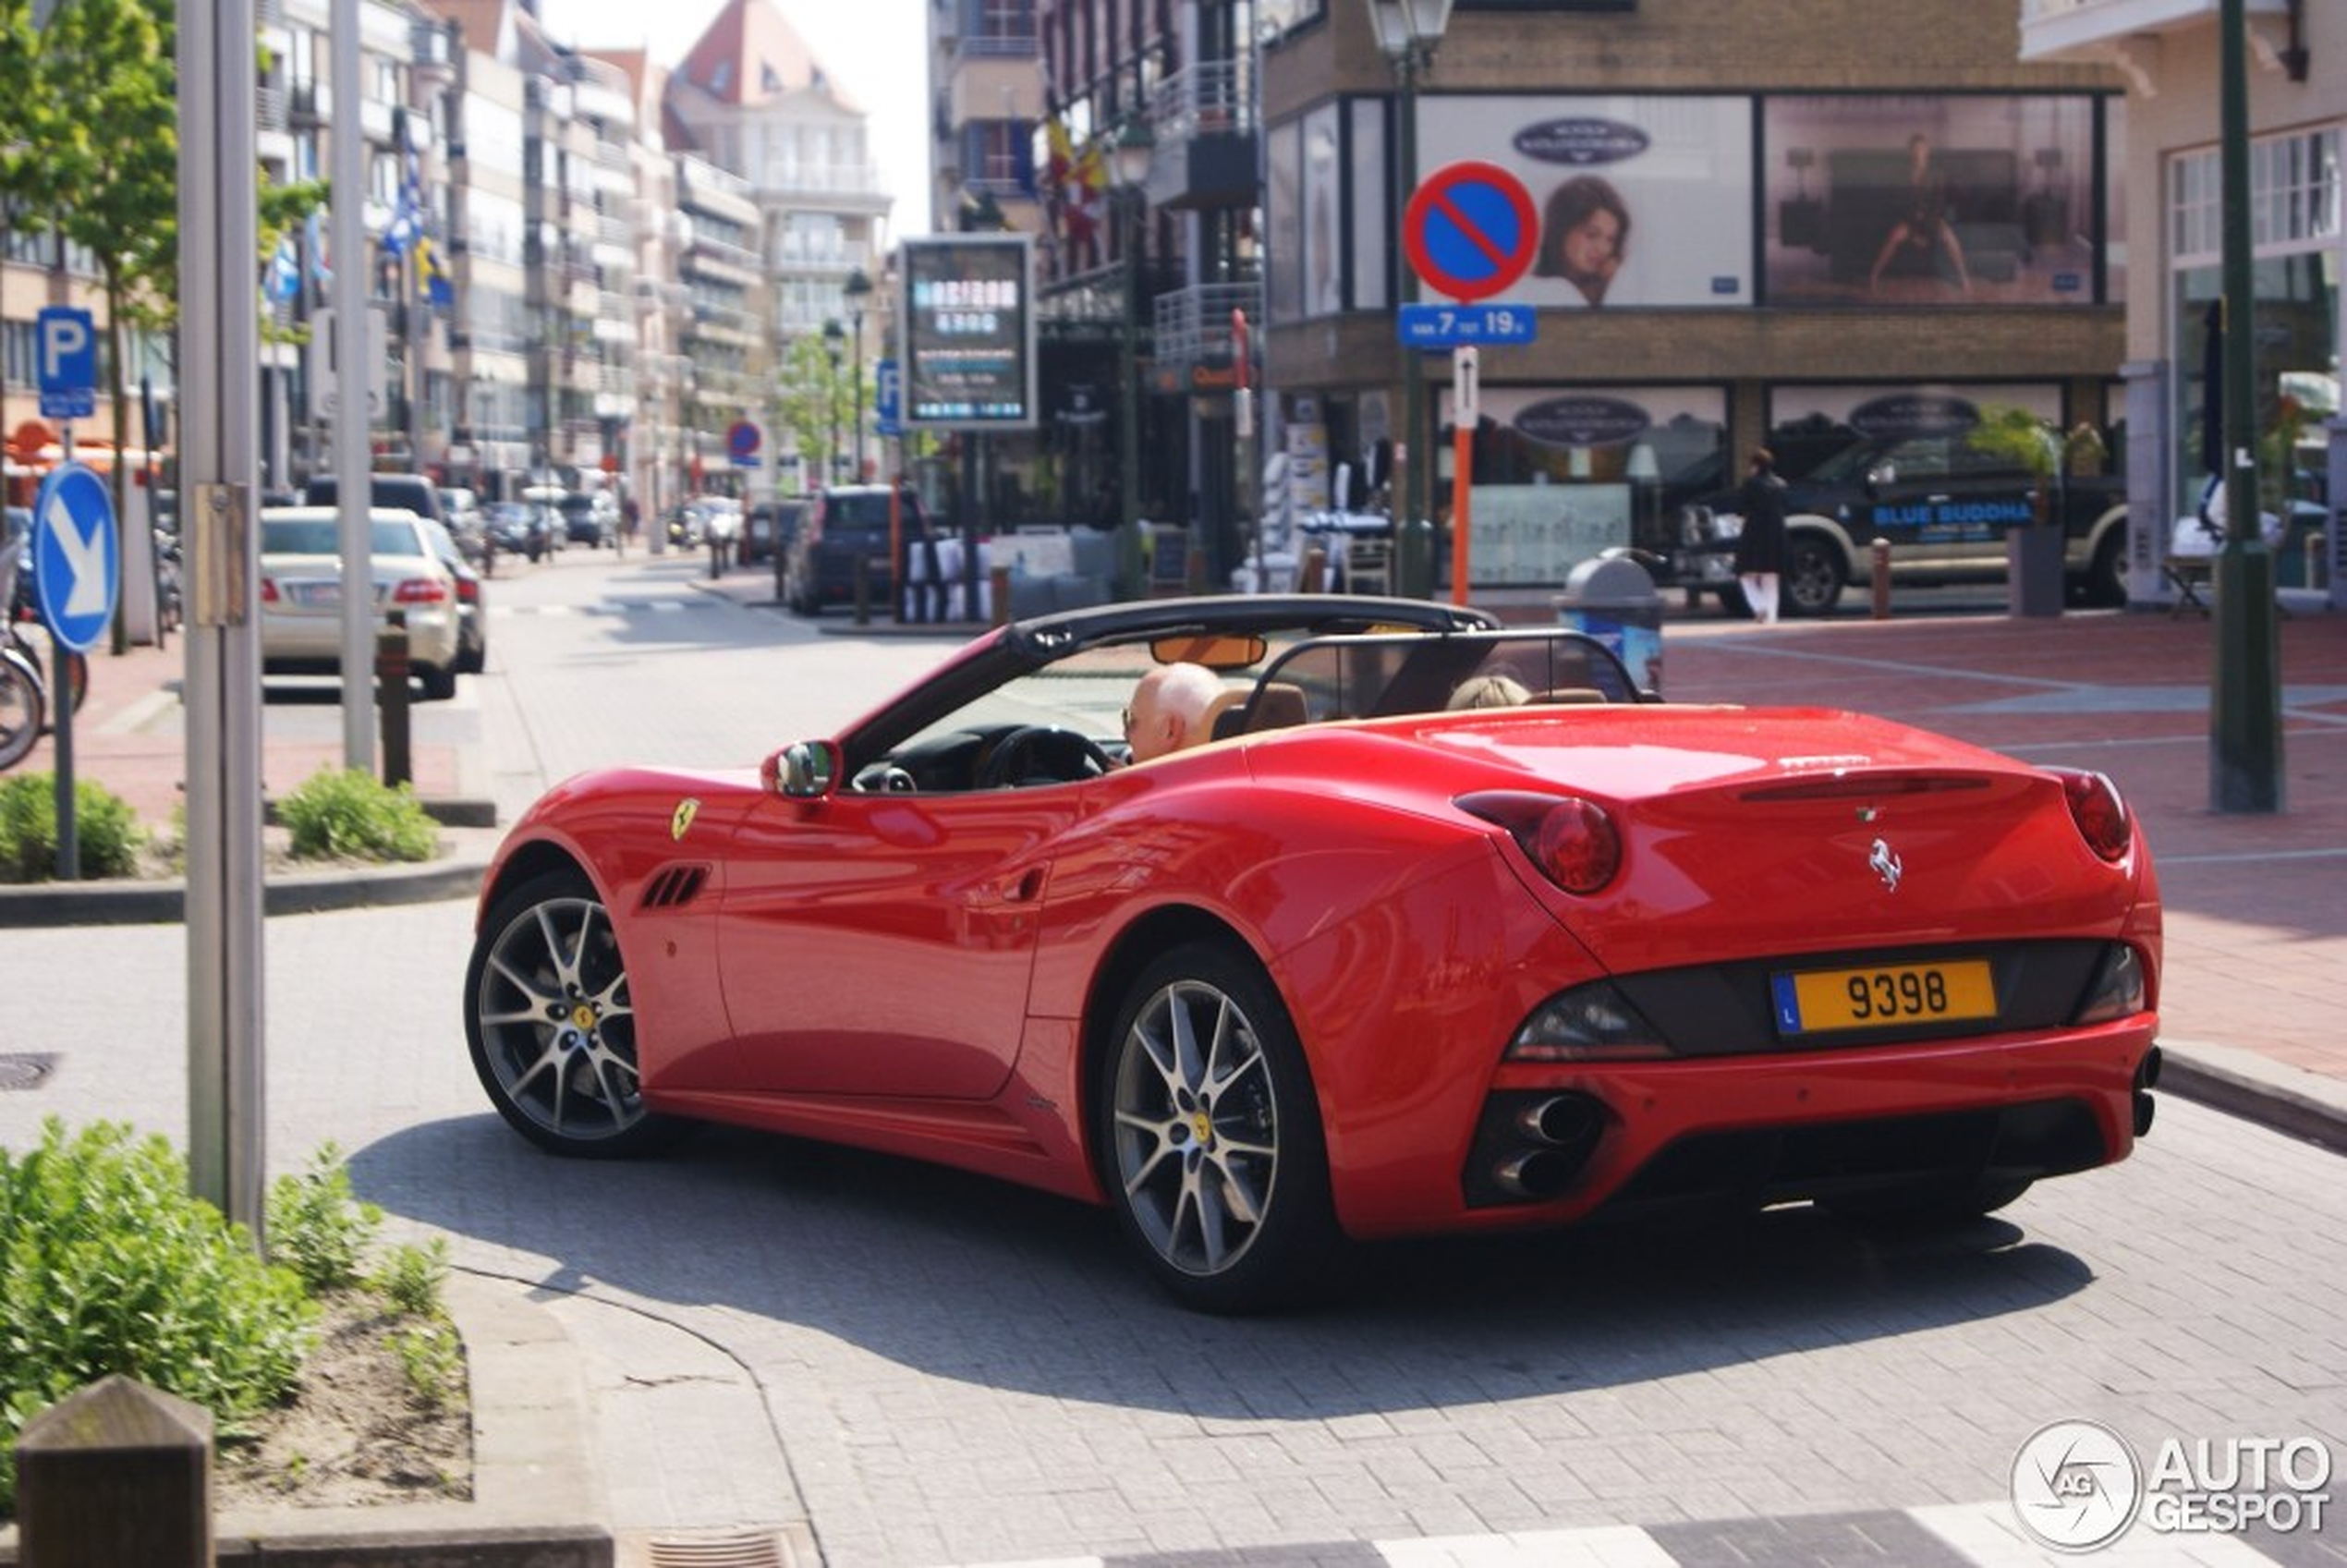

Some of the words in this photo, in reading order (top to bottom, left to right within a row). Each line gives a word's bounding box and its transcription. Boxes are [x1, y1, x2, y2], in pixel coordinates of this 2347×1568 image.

[1438, 311, 1456, 334] 7
[1486, 310, 1514, 334] 19
[44, 318, 87, 378] P
[1873, 505, 1932, 525] BLUE
[1937, 502, 2032, 521] BUDDHA
[1847, 970, 1948, 1019] 9398
[1783, 1008, 1794, 1024] L
